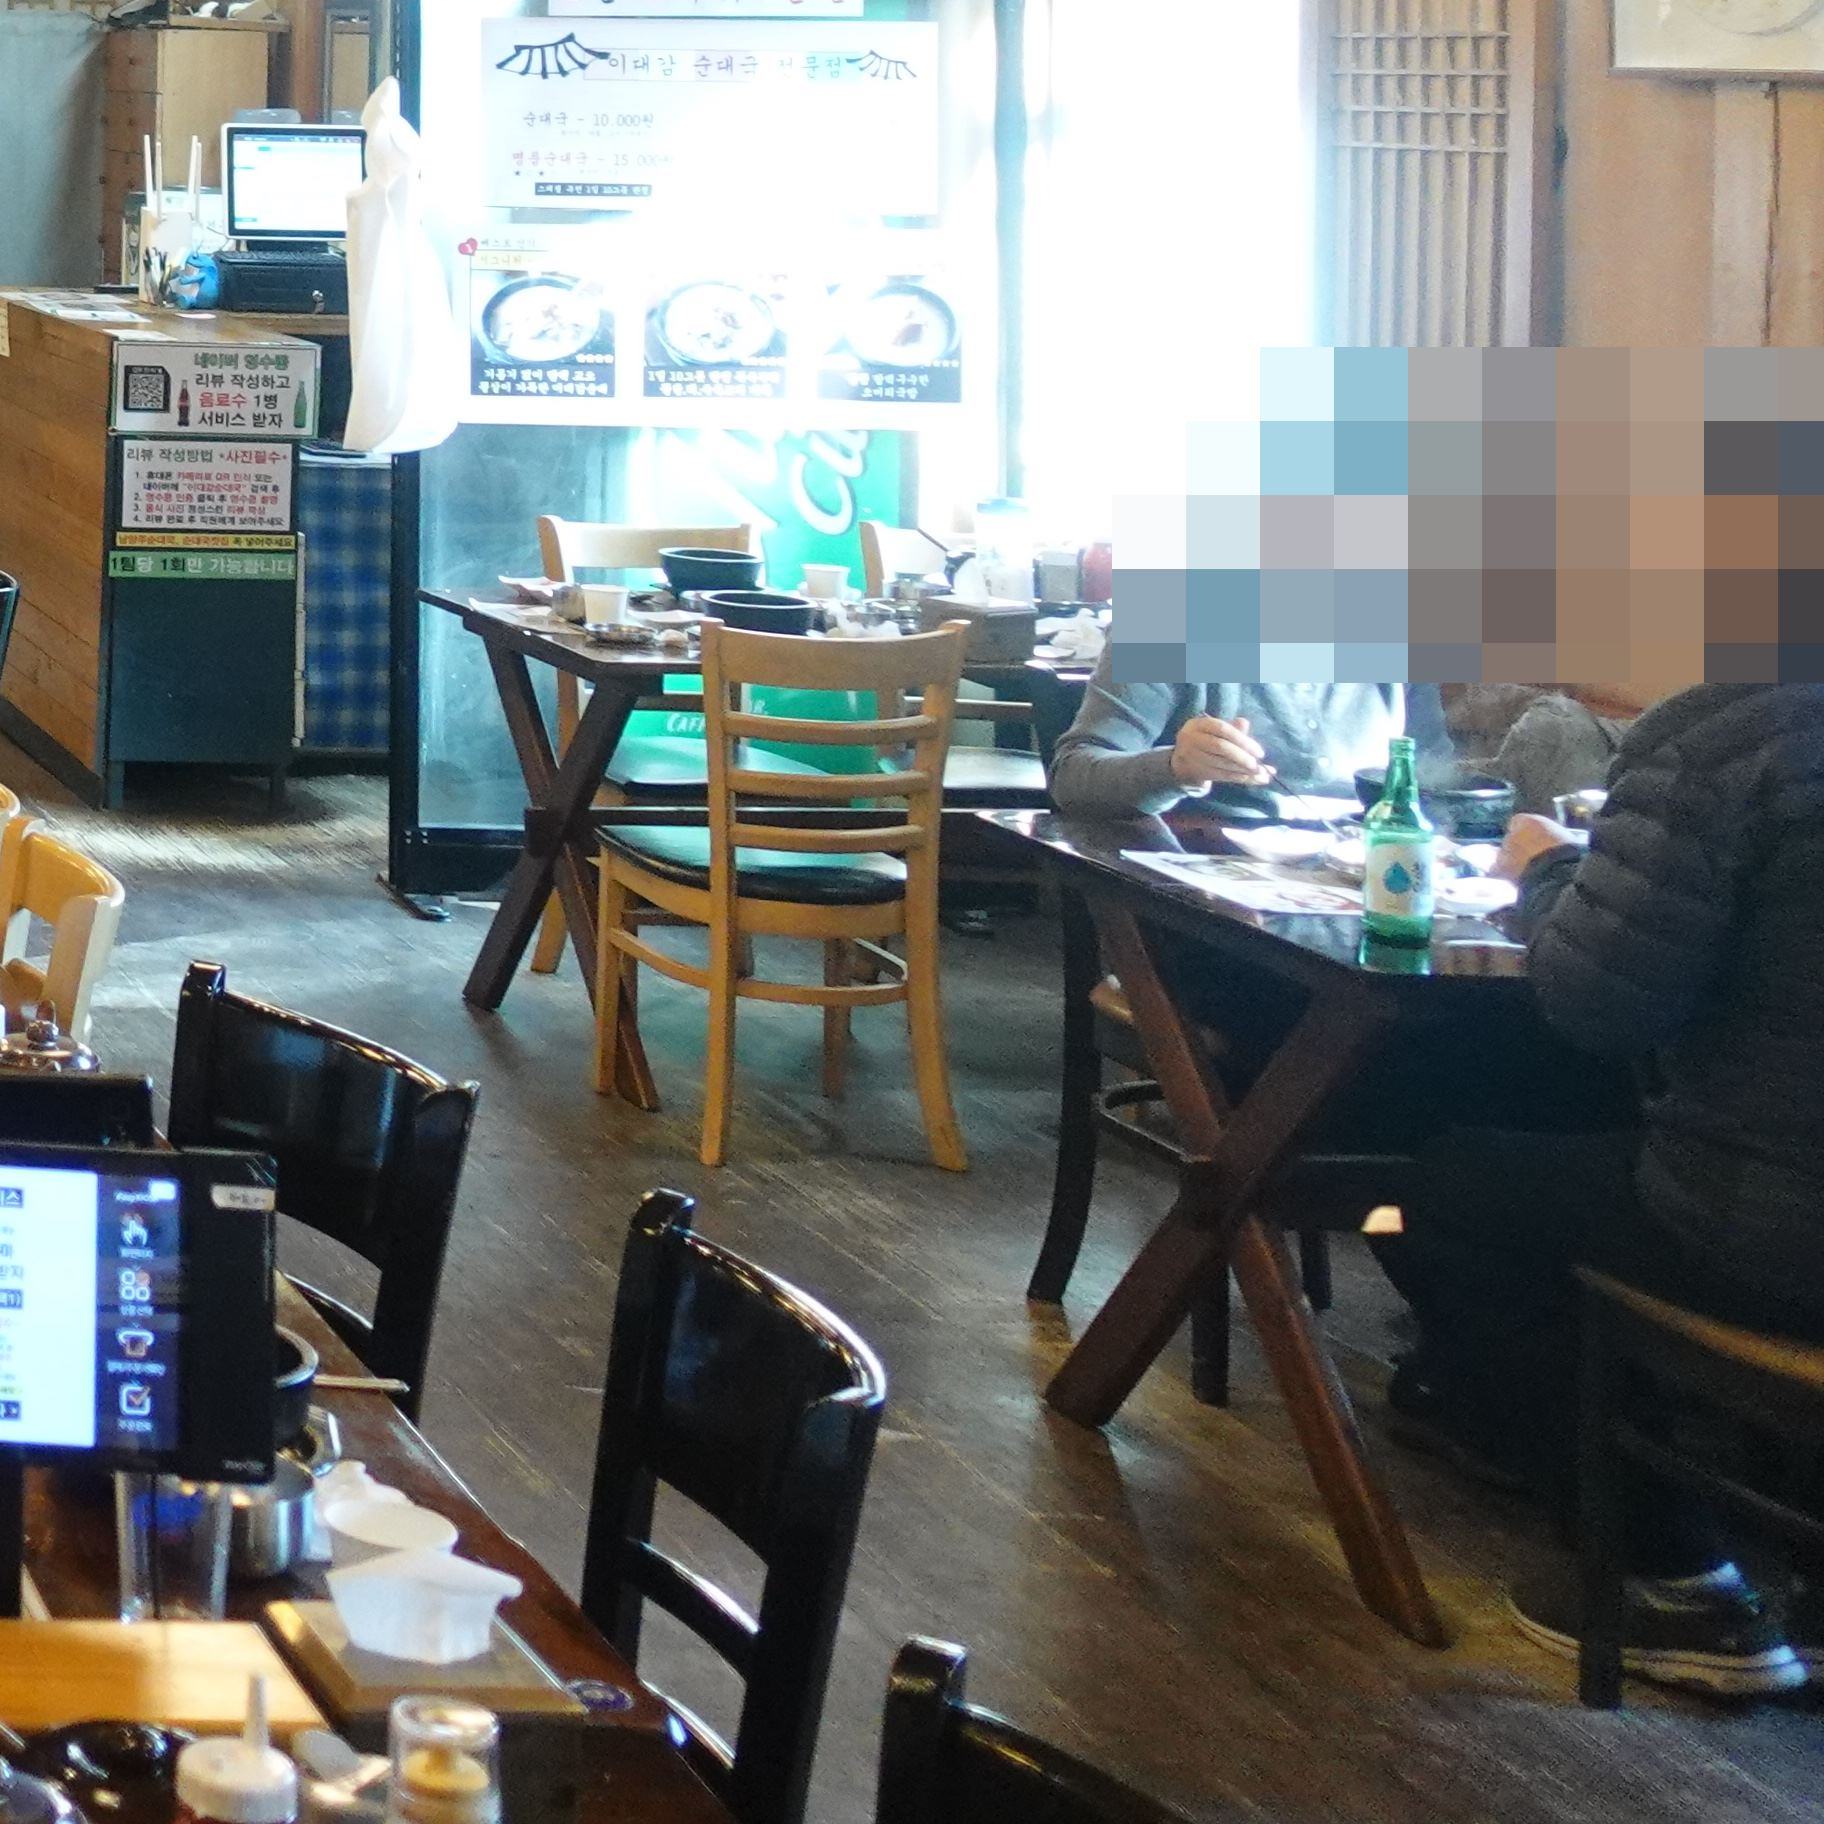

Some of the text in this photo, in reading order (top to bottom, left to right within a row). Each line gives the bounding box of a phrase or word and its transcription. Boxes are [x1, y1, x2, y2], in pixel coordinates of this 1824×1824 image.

[608, 53, 842, 81] 이대감 순대국 전문점
[522, 111, 569, 128] 순대국
[193, 352, 290, 371] 네이버 영수증
[195, 373, 291, 390] 리뷰 작성하고
[198, 392, 279, 410] 음료수 1병
[198, 411, 284, 429] 서비스 받자
[126, 448, 154, 462] 리뷰
[159, 448, 214, 464] 작성방법
[209, 558, 295, 577] 가능합니다
